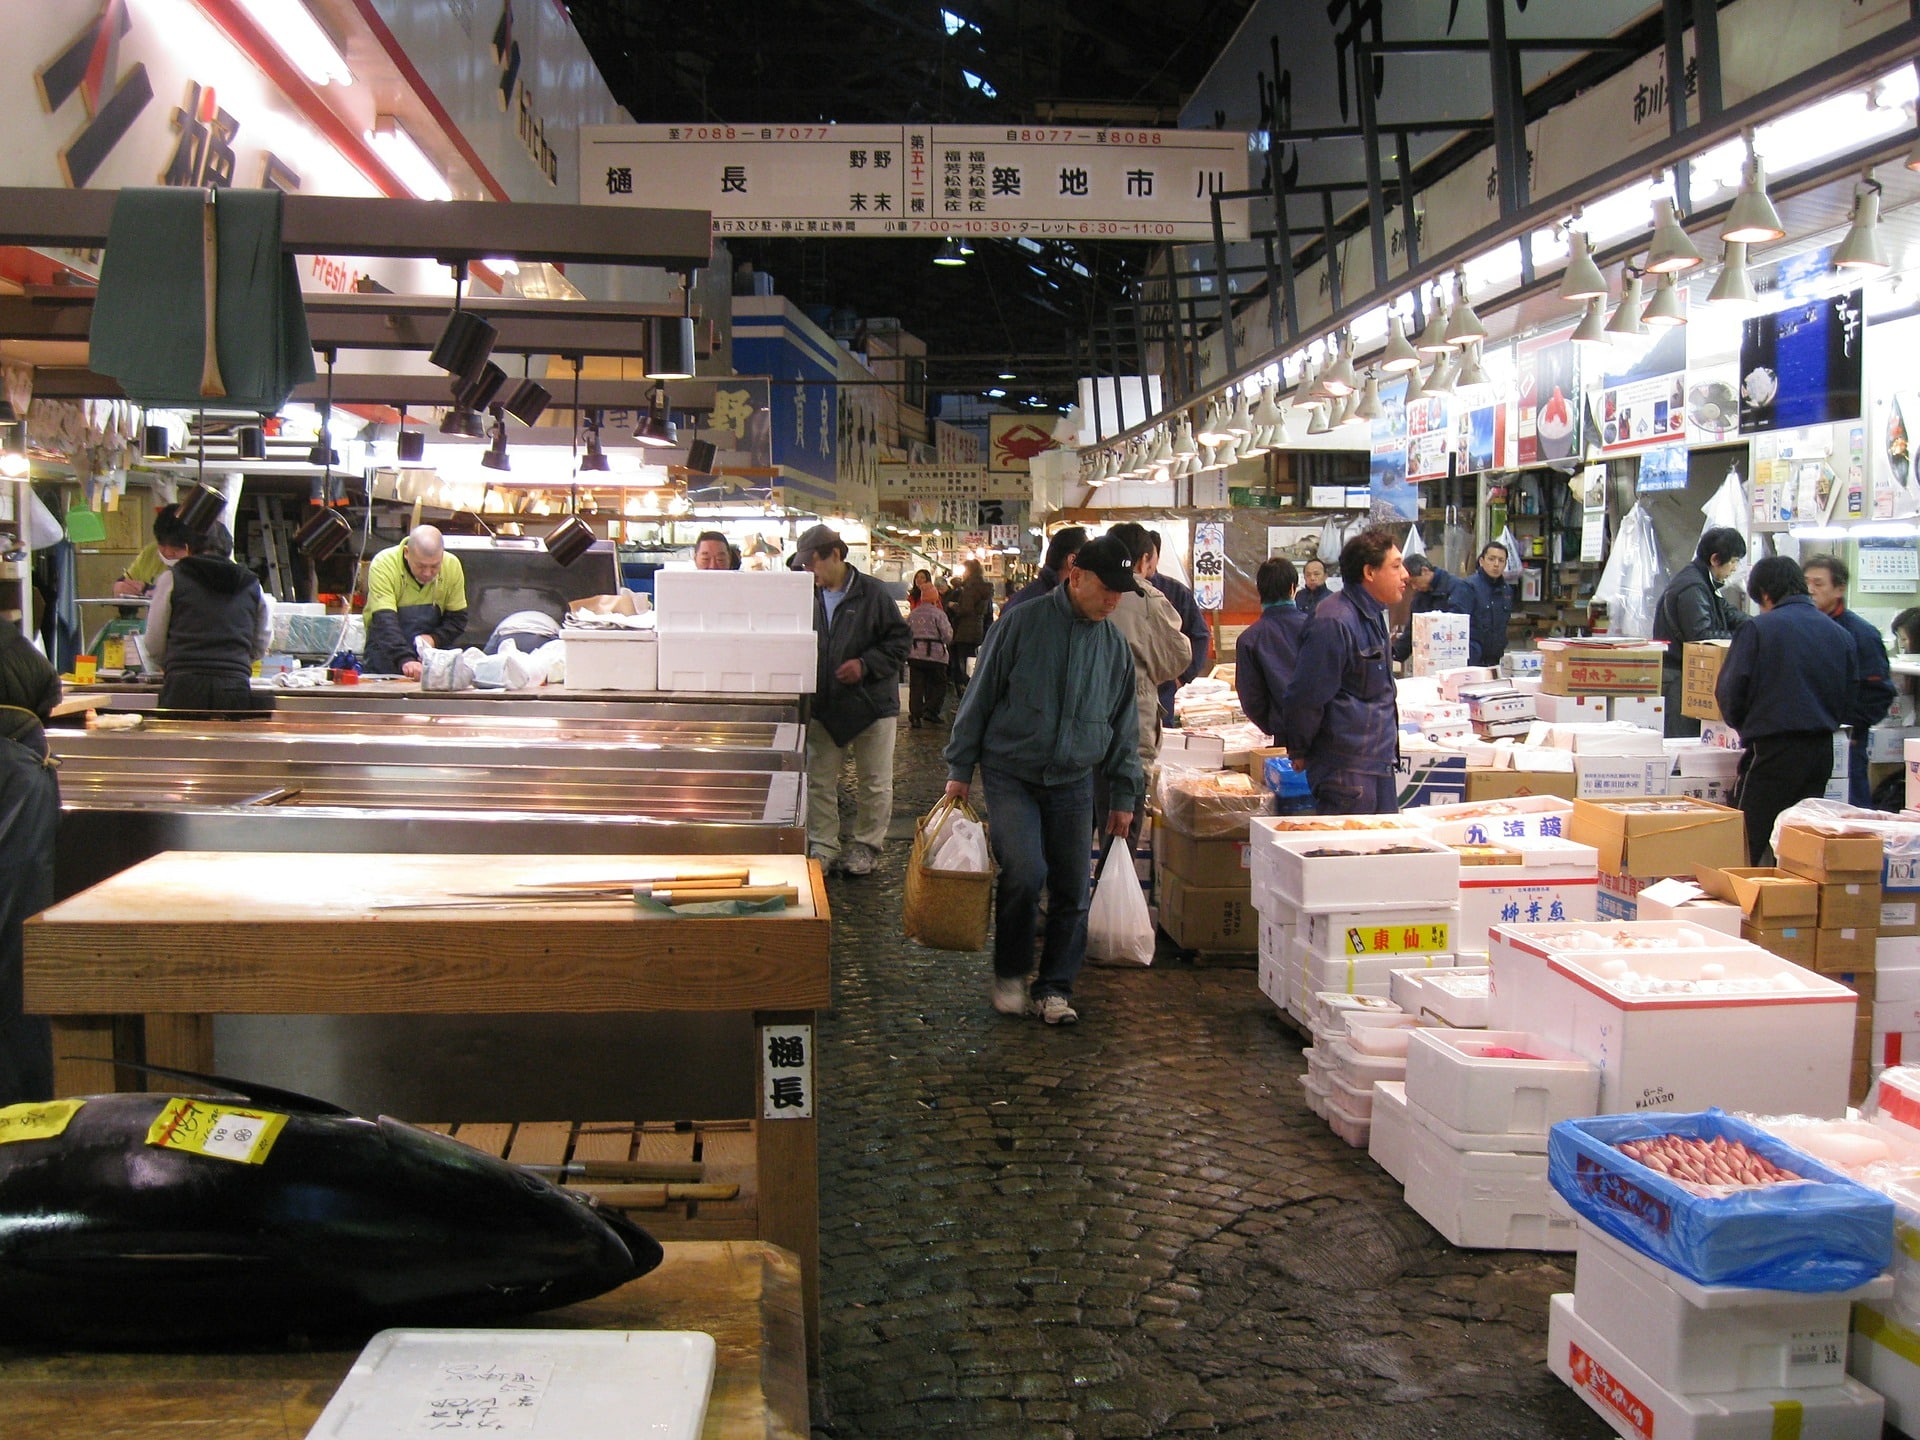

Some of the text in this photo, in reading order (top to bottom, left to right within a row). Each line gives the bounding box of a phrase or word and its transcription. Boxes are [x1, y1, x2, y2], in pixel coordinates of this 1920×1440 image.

[992, 166, 1223, 197] 築地市川
[768, 1036, 804, 1109] 樋長
